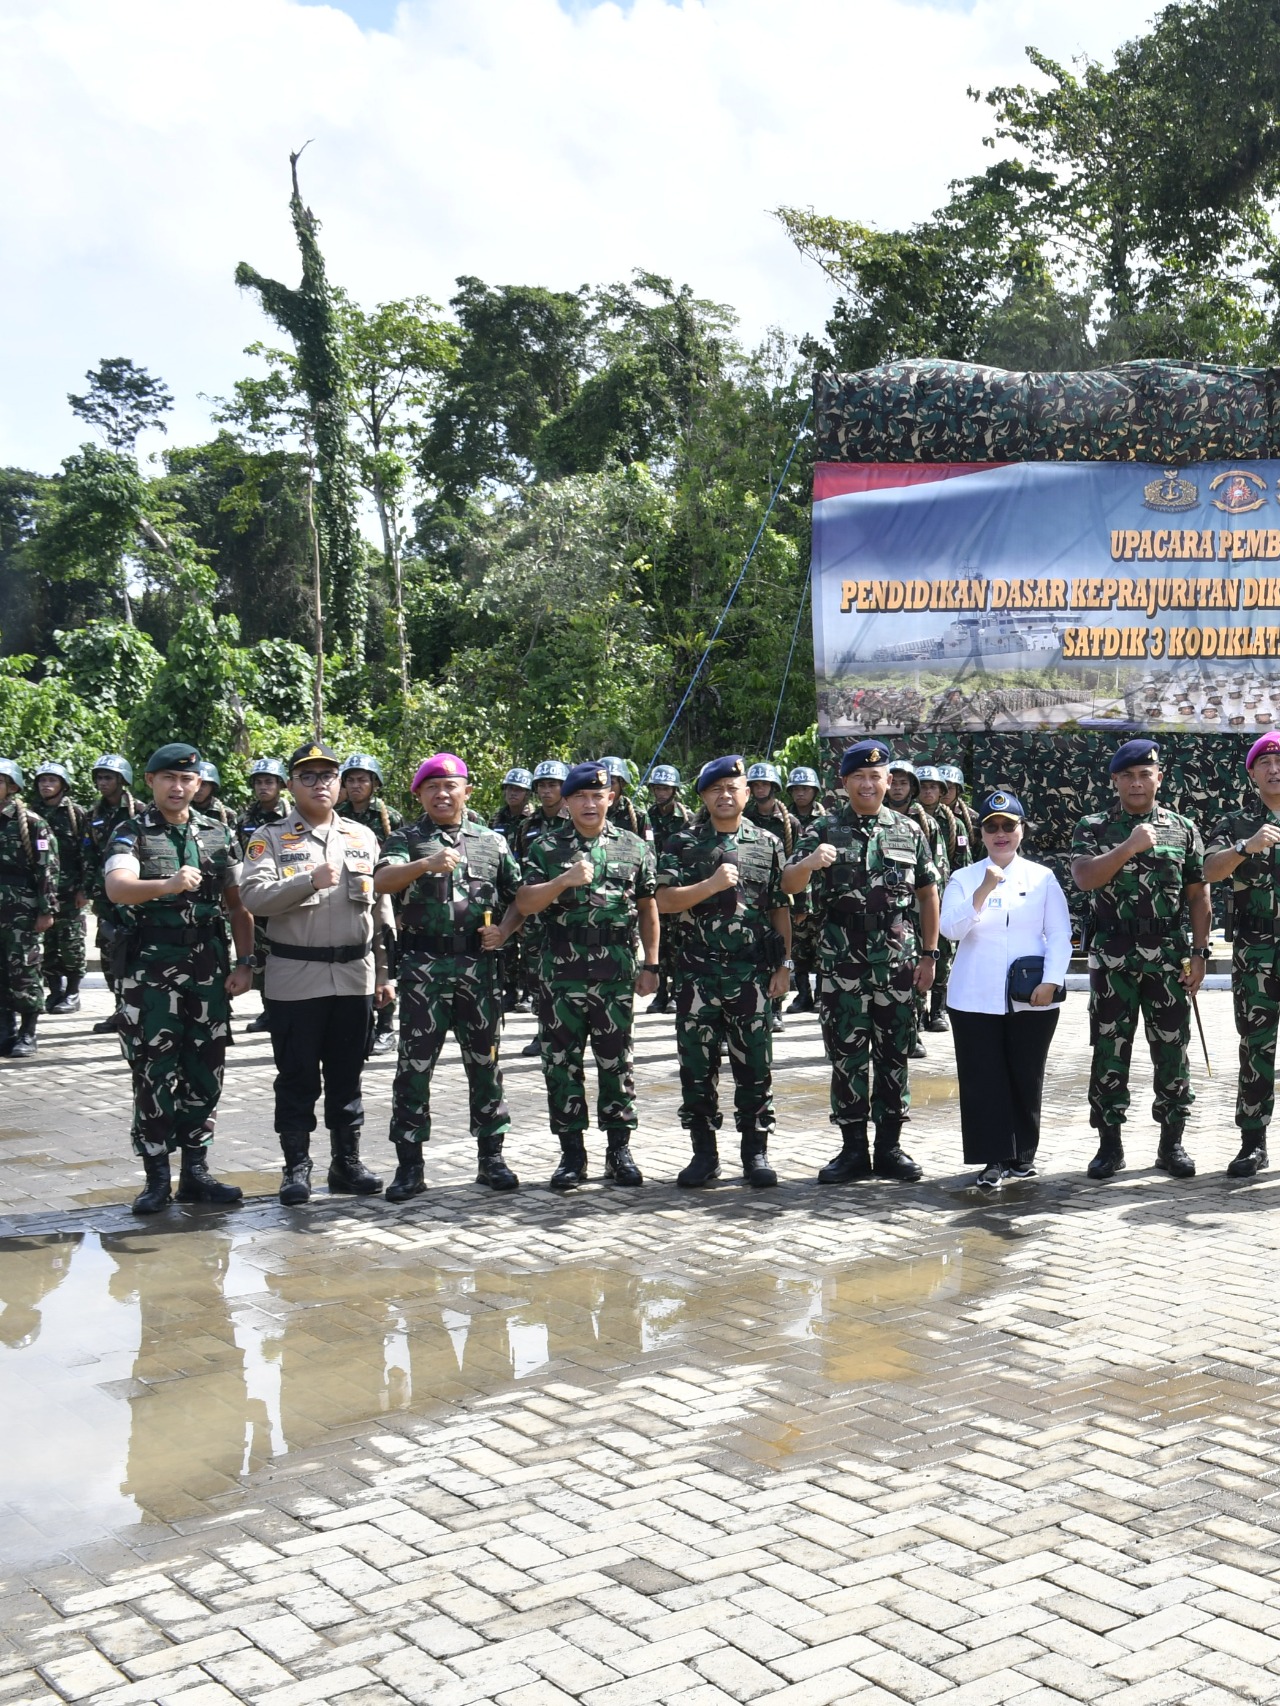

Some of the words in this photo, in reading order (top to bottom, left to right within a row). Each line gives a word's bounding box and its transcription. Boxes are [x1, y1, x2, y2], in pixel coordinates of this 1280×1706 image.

[1110, 529, 1214, 561] UPACARA
[840, 579, 988, 613] PENDIDIKAN
[991, 578, 1067, 612] DASAR
[1070, 577, 1240, 619] KEPRAJURITAN
[1062, 626, 1148, 660] SATDIK
[1150, 627, 1165, 659] 3
